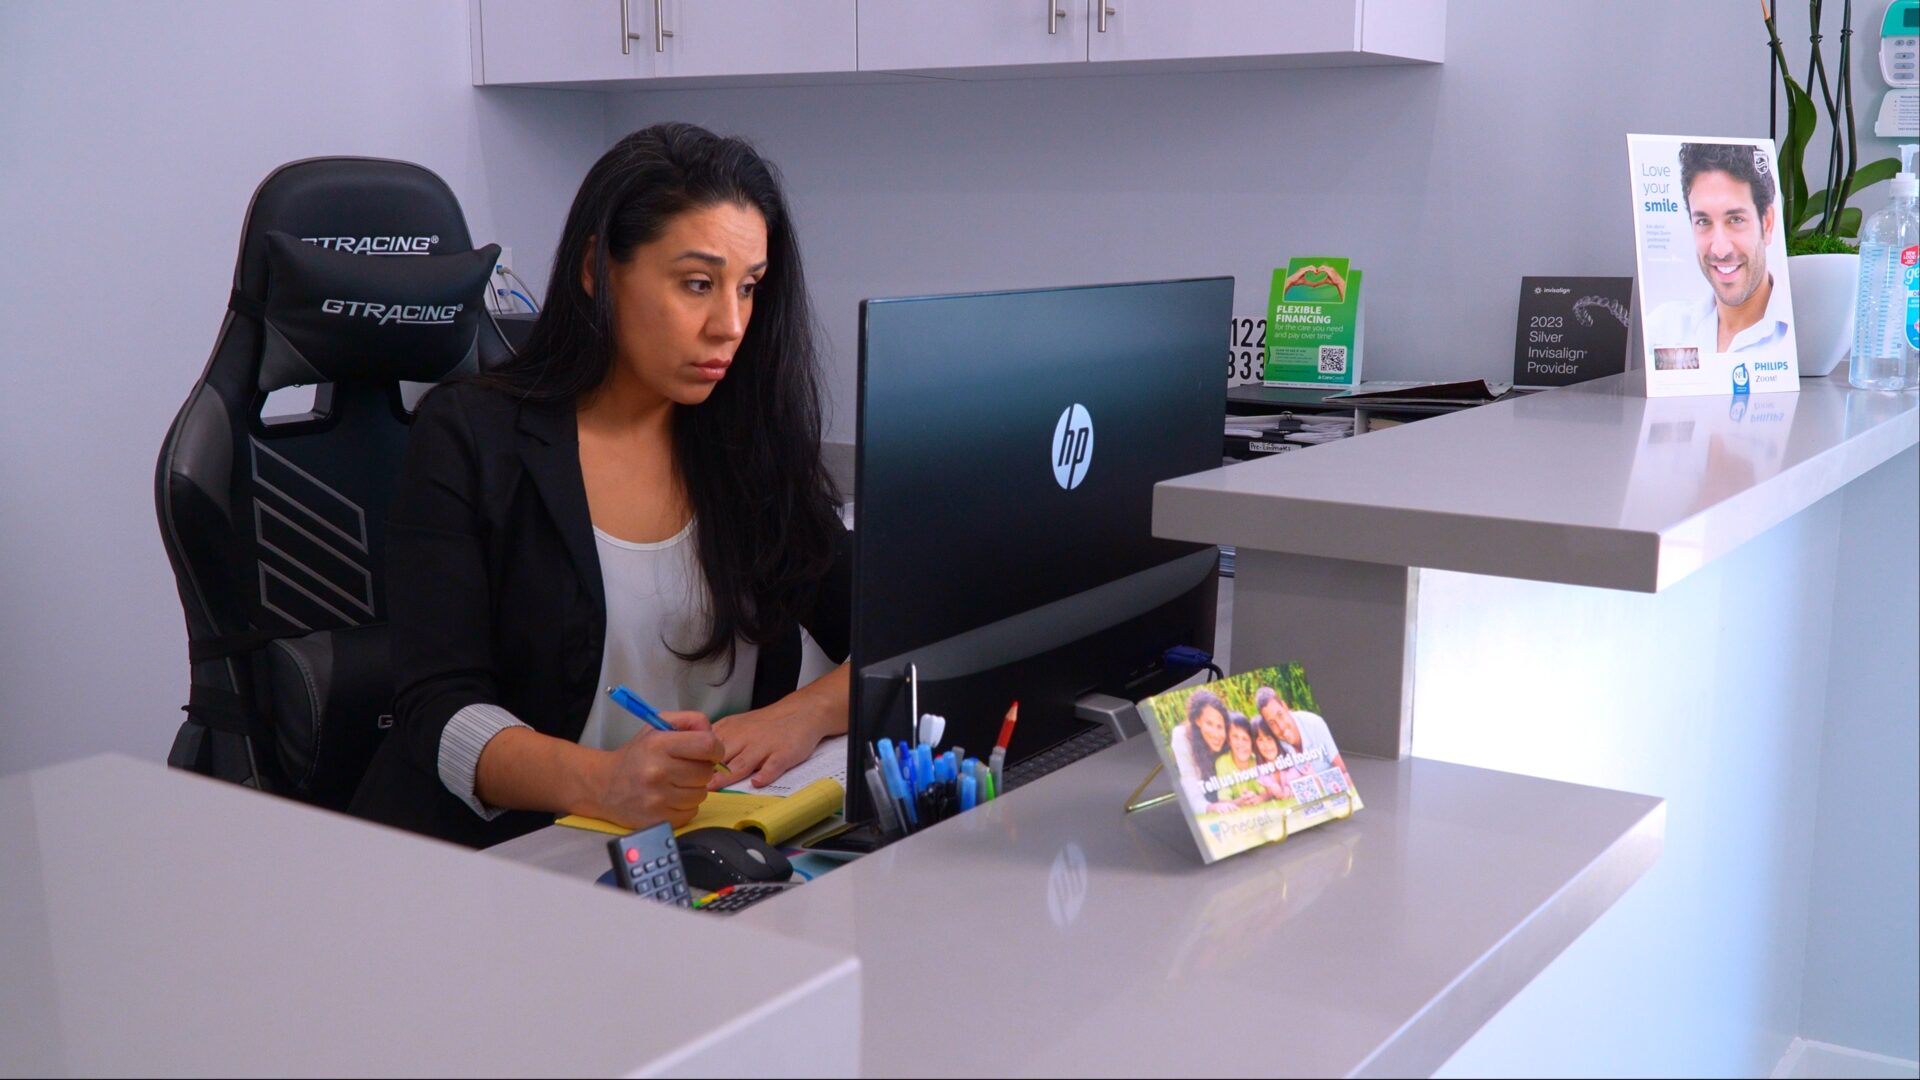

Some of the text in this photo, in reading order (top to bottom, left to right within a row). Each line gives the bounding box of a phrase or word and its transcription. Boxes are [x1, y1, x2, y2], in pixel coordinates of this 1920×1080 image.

[1642, 163, 1671, 177] Love
[1643, 183, 1670, 196] your
[1644, 198, 1679, 212] smile
[1276, 305, 1322, 315] FLEXIBLE
[1275, 314, 1332, 324] FINANCING
[1530, 316, 1564, 328] 2023
[1275, 323, 1285, 331] for
[1275, 331, 1287, 339] and
[1287, 333, 1300, 341] pay
[1529, 331, 1563, 343] Silver
[1527, 361, 1579, 374] Provider
[1754, 361, 1789, 371] PHILIPS
[1056, 403, 1090, 490] hp
[1198, 776, 1220, 794] Tell
[1219, 775, 1234, 786] us
[1233, 768, 1260, 783] how
[1257, 763, 1276, 777] we
[1274, 756, 1294, 771] did
